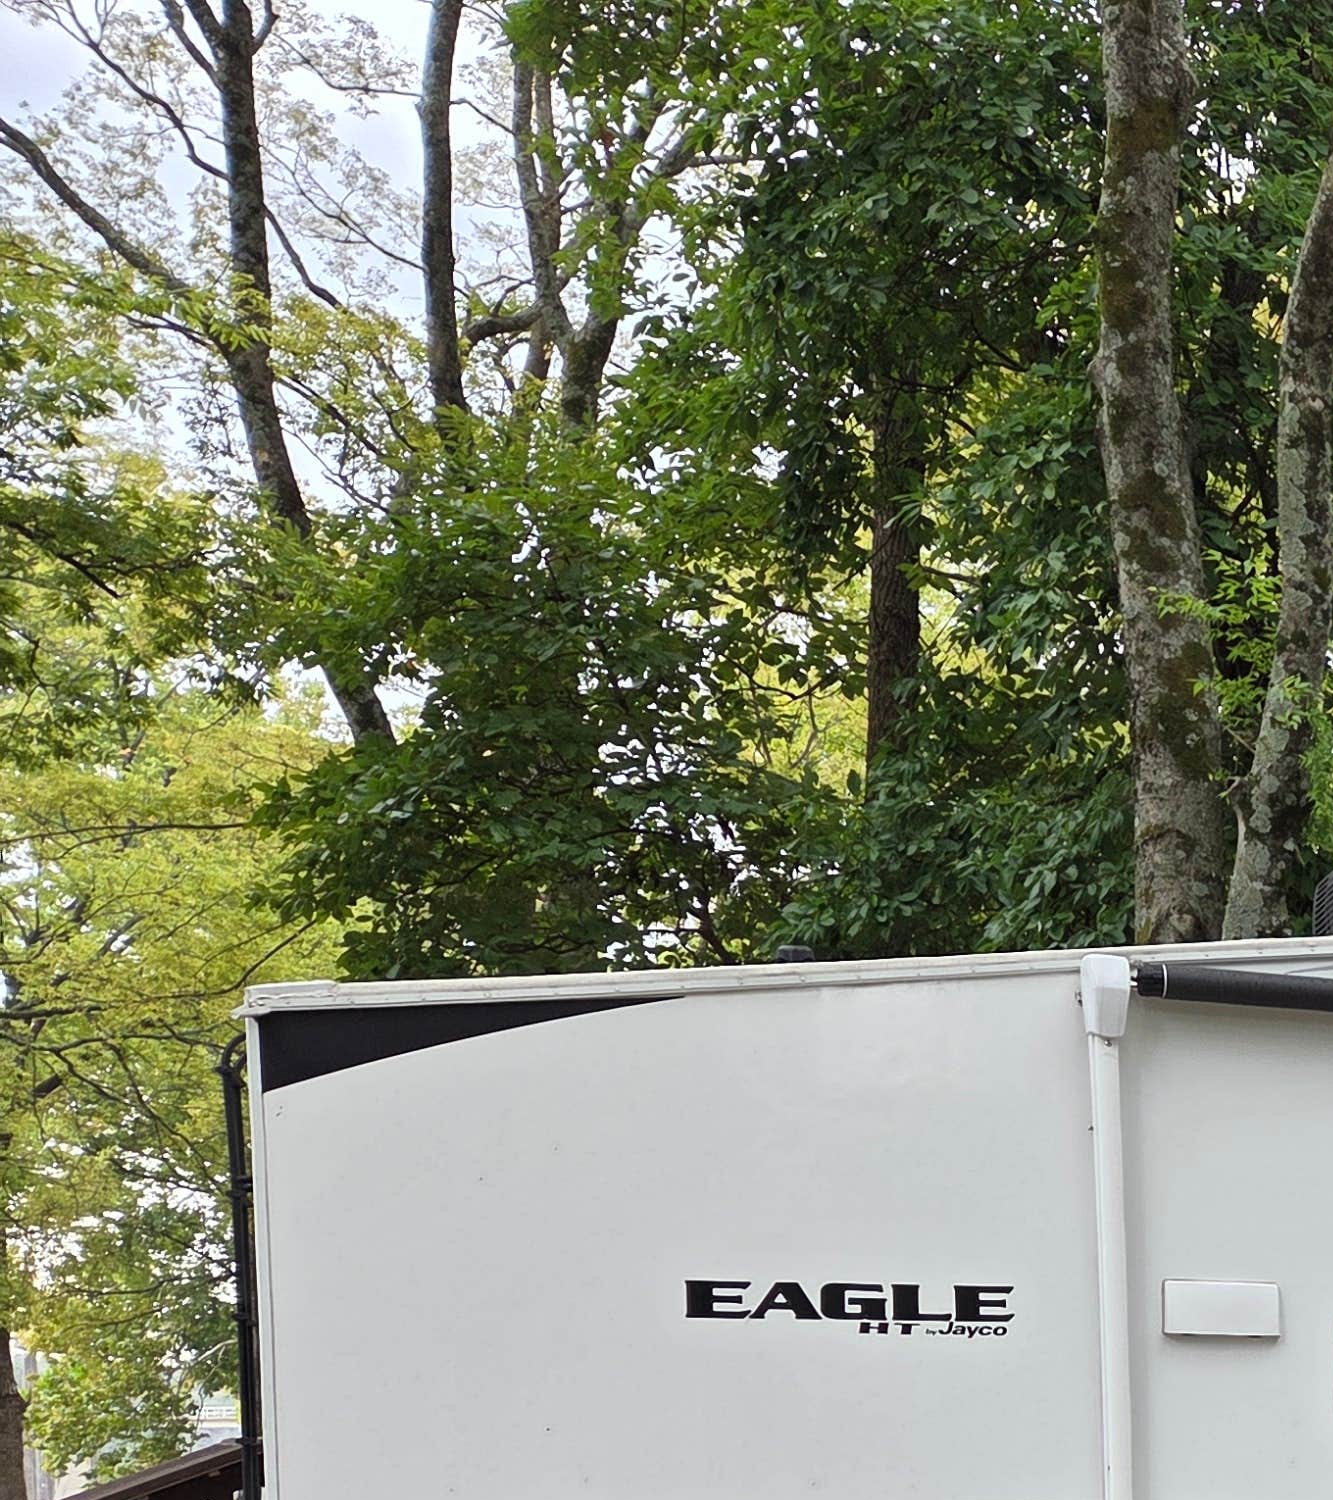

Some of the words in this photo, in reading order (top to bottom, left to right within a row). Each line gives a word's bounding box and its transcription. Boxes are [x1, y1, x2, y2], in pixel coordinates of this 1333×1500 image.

[684, 1279, 1015, 1323] EAGLE
[859, 1321, 921, 1335] HT
[938, 1320, 1008, 1339] Jayco
